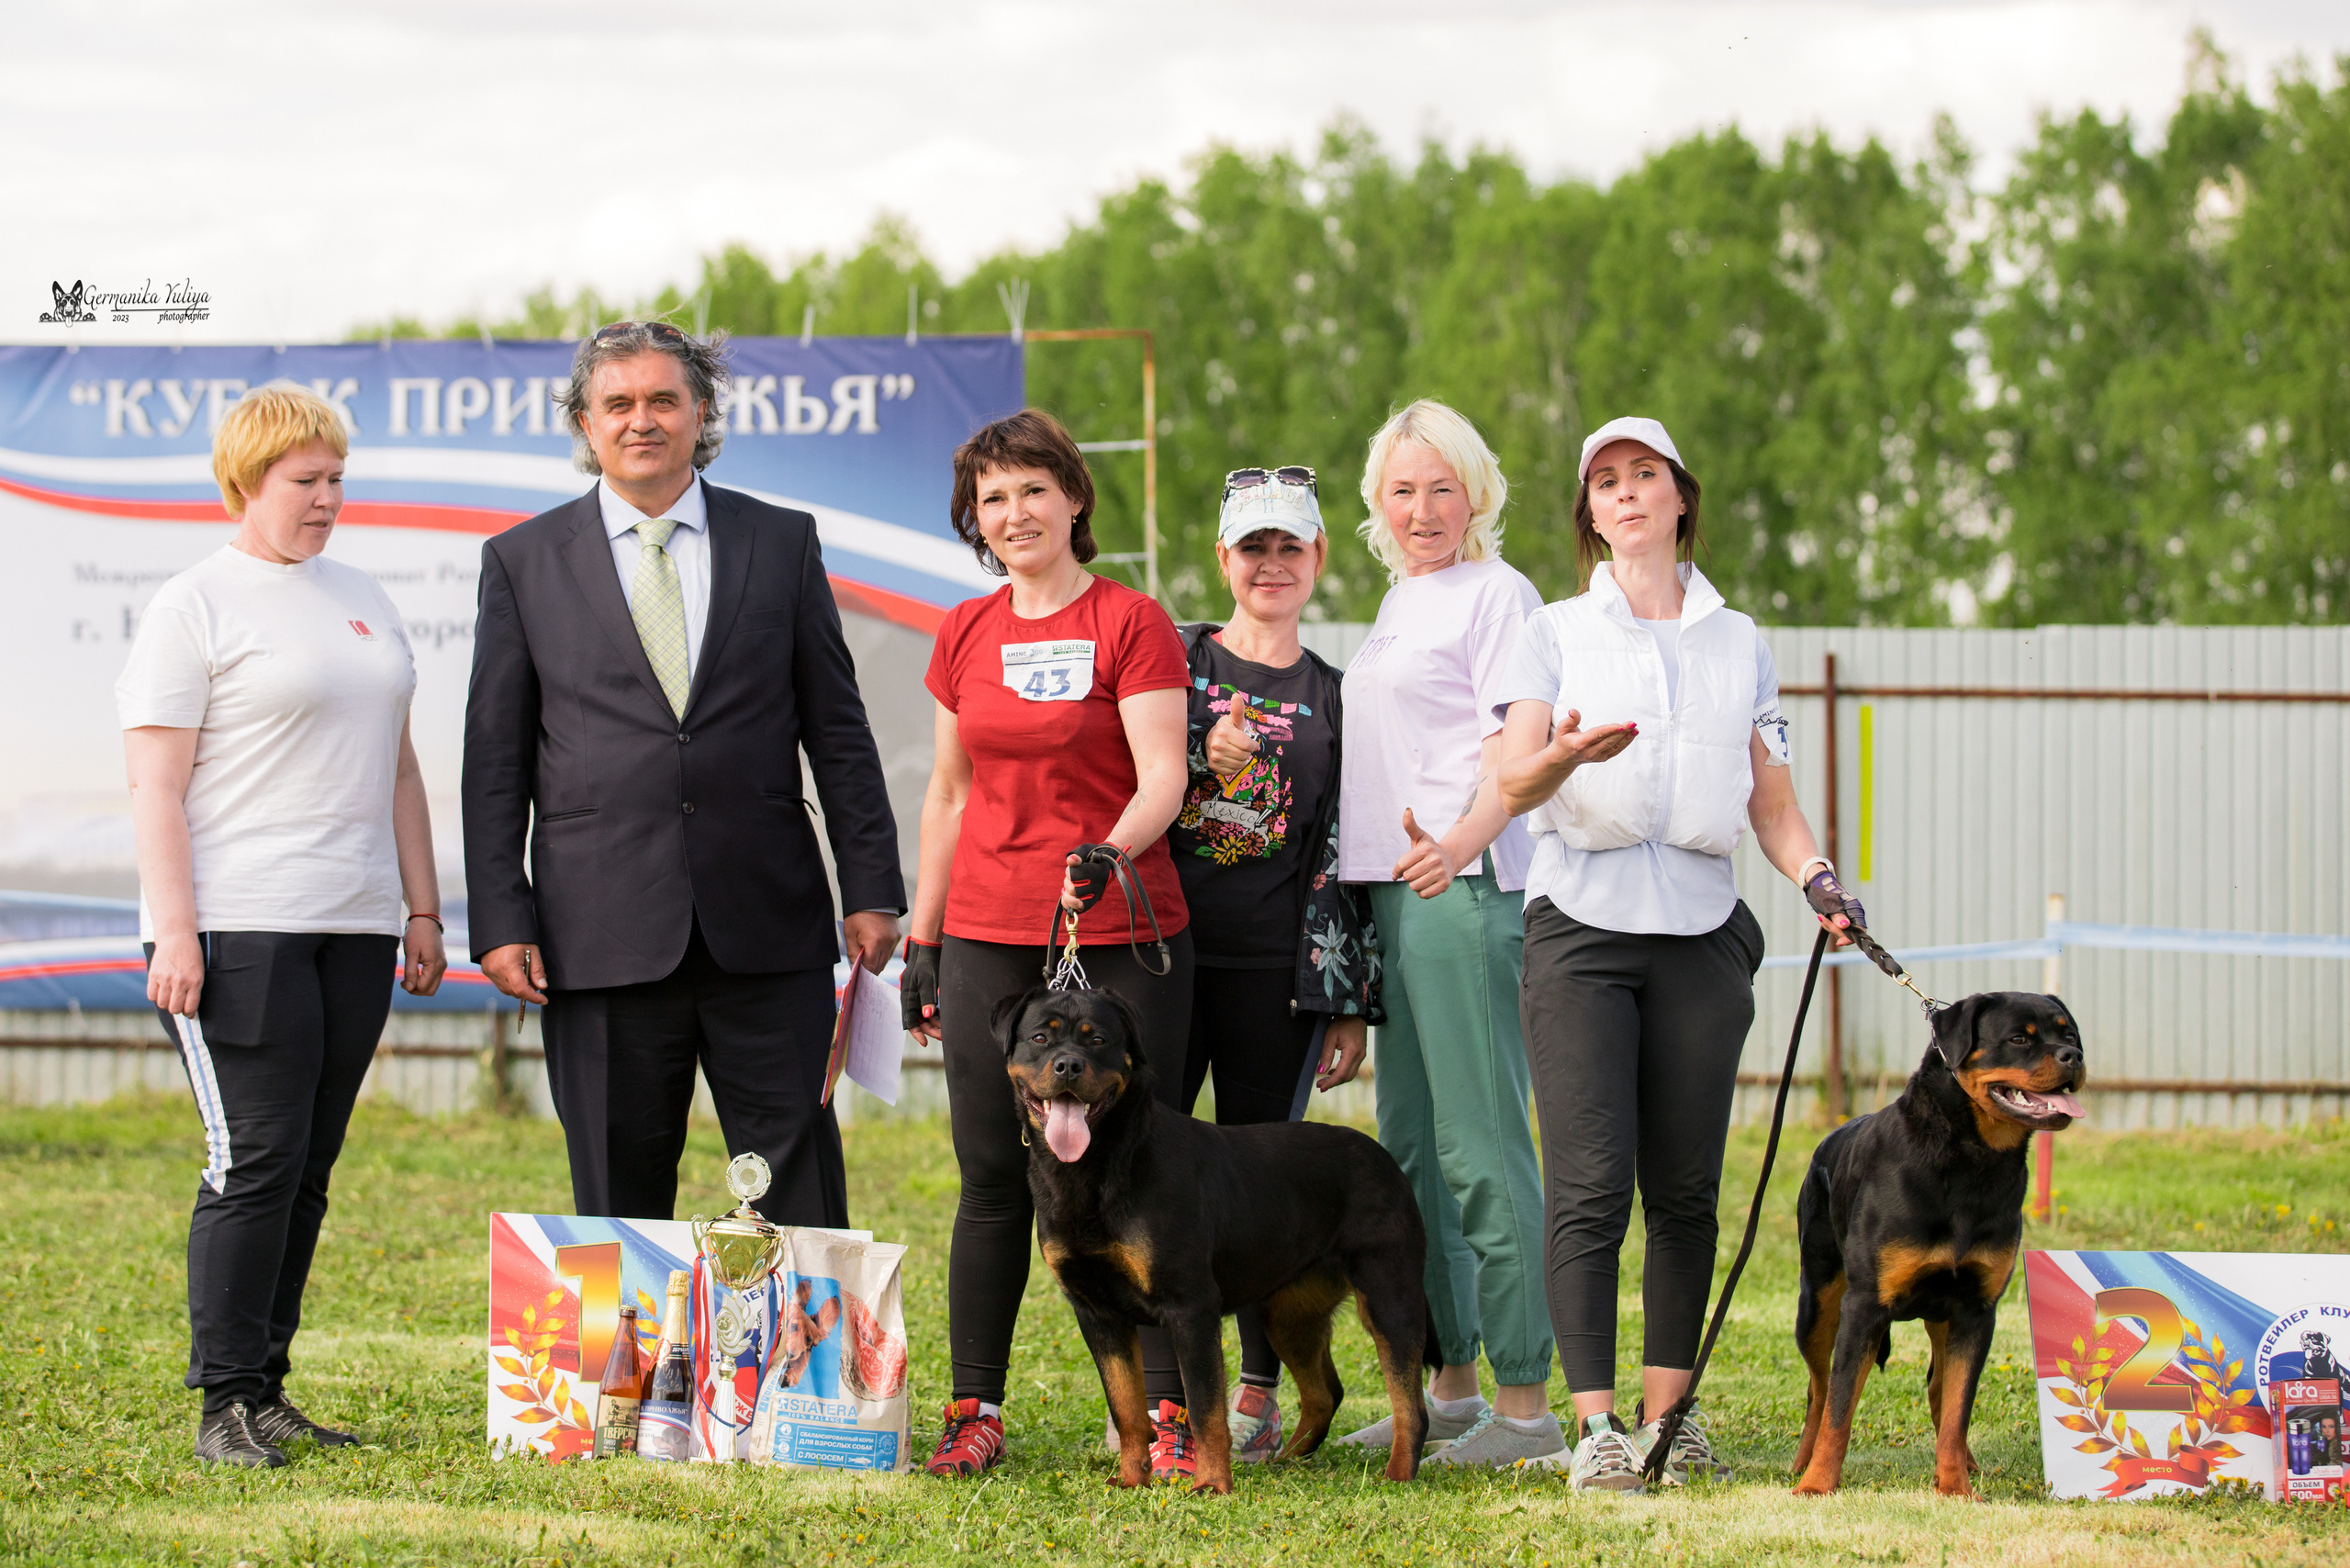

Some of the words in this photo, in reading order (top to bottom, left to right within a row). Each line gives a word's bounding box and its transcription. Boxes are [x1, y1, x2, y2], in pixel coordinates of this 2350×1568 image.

[1023, 668, 1071, 698] 43
[555, 1240, 622, 1383] 1
[2095, 1287, 2196, 1413] 2
[2258, 1309, 2309, 1386] РОТВЕЙЛЕР
[2284, 1381, 2318, 1399] lara
[789, 1398, 857, 1417] STATERA
[810, 1415, 845, 1424] BALANCE
[798, 1438, 814, 1446] ДЛЯ
[814, 1440, 851, 1450] ВЗРОСЛЫХ
[800, 1431, 858, 1442] СБАЛАНСИРОВАННЫЙ
[804, 1451, 845, 1462] ЛОСОСЕМ
[882, 1460, 888, 1468] 3
[2142, 1465, 2173, 1474] место
